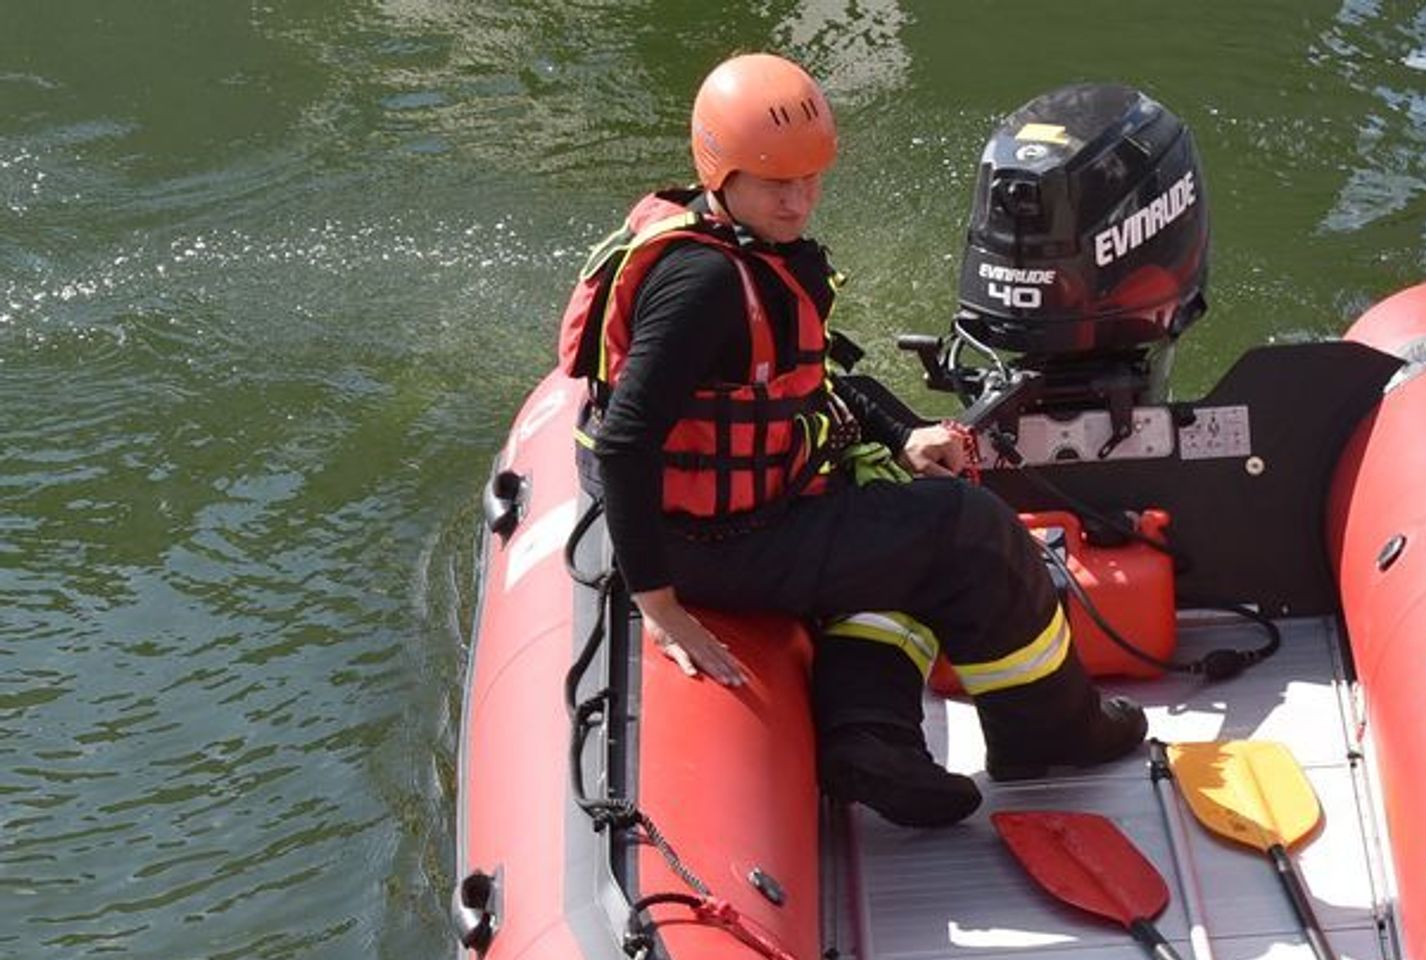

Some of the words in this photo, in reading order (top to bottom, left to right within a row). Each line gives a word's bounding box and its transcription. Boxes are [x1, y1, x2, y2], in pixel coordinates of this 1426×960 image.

[1095, 171, 1196, 267] EVINRUDE
[979, 263, 1056, 284] EVINRUDE
[988, 283, 1042, 308] 40
